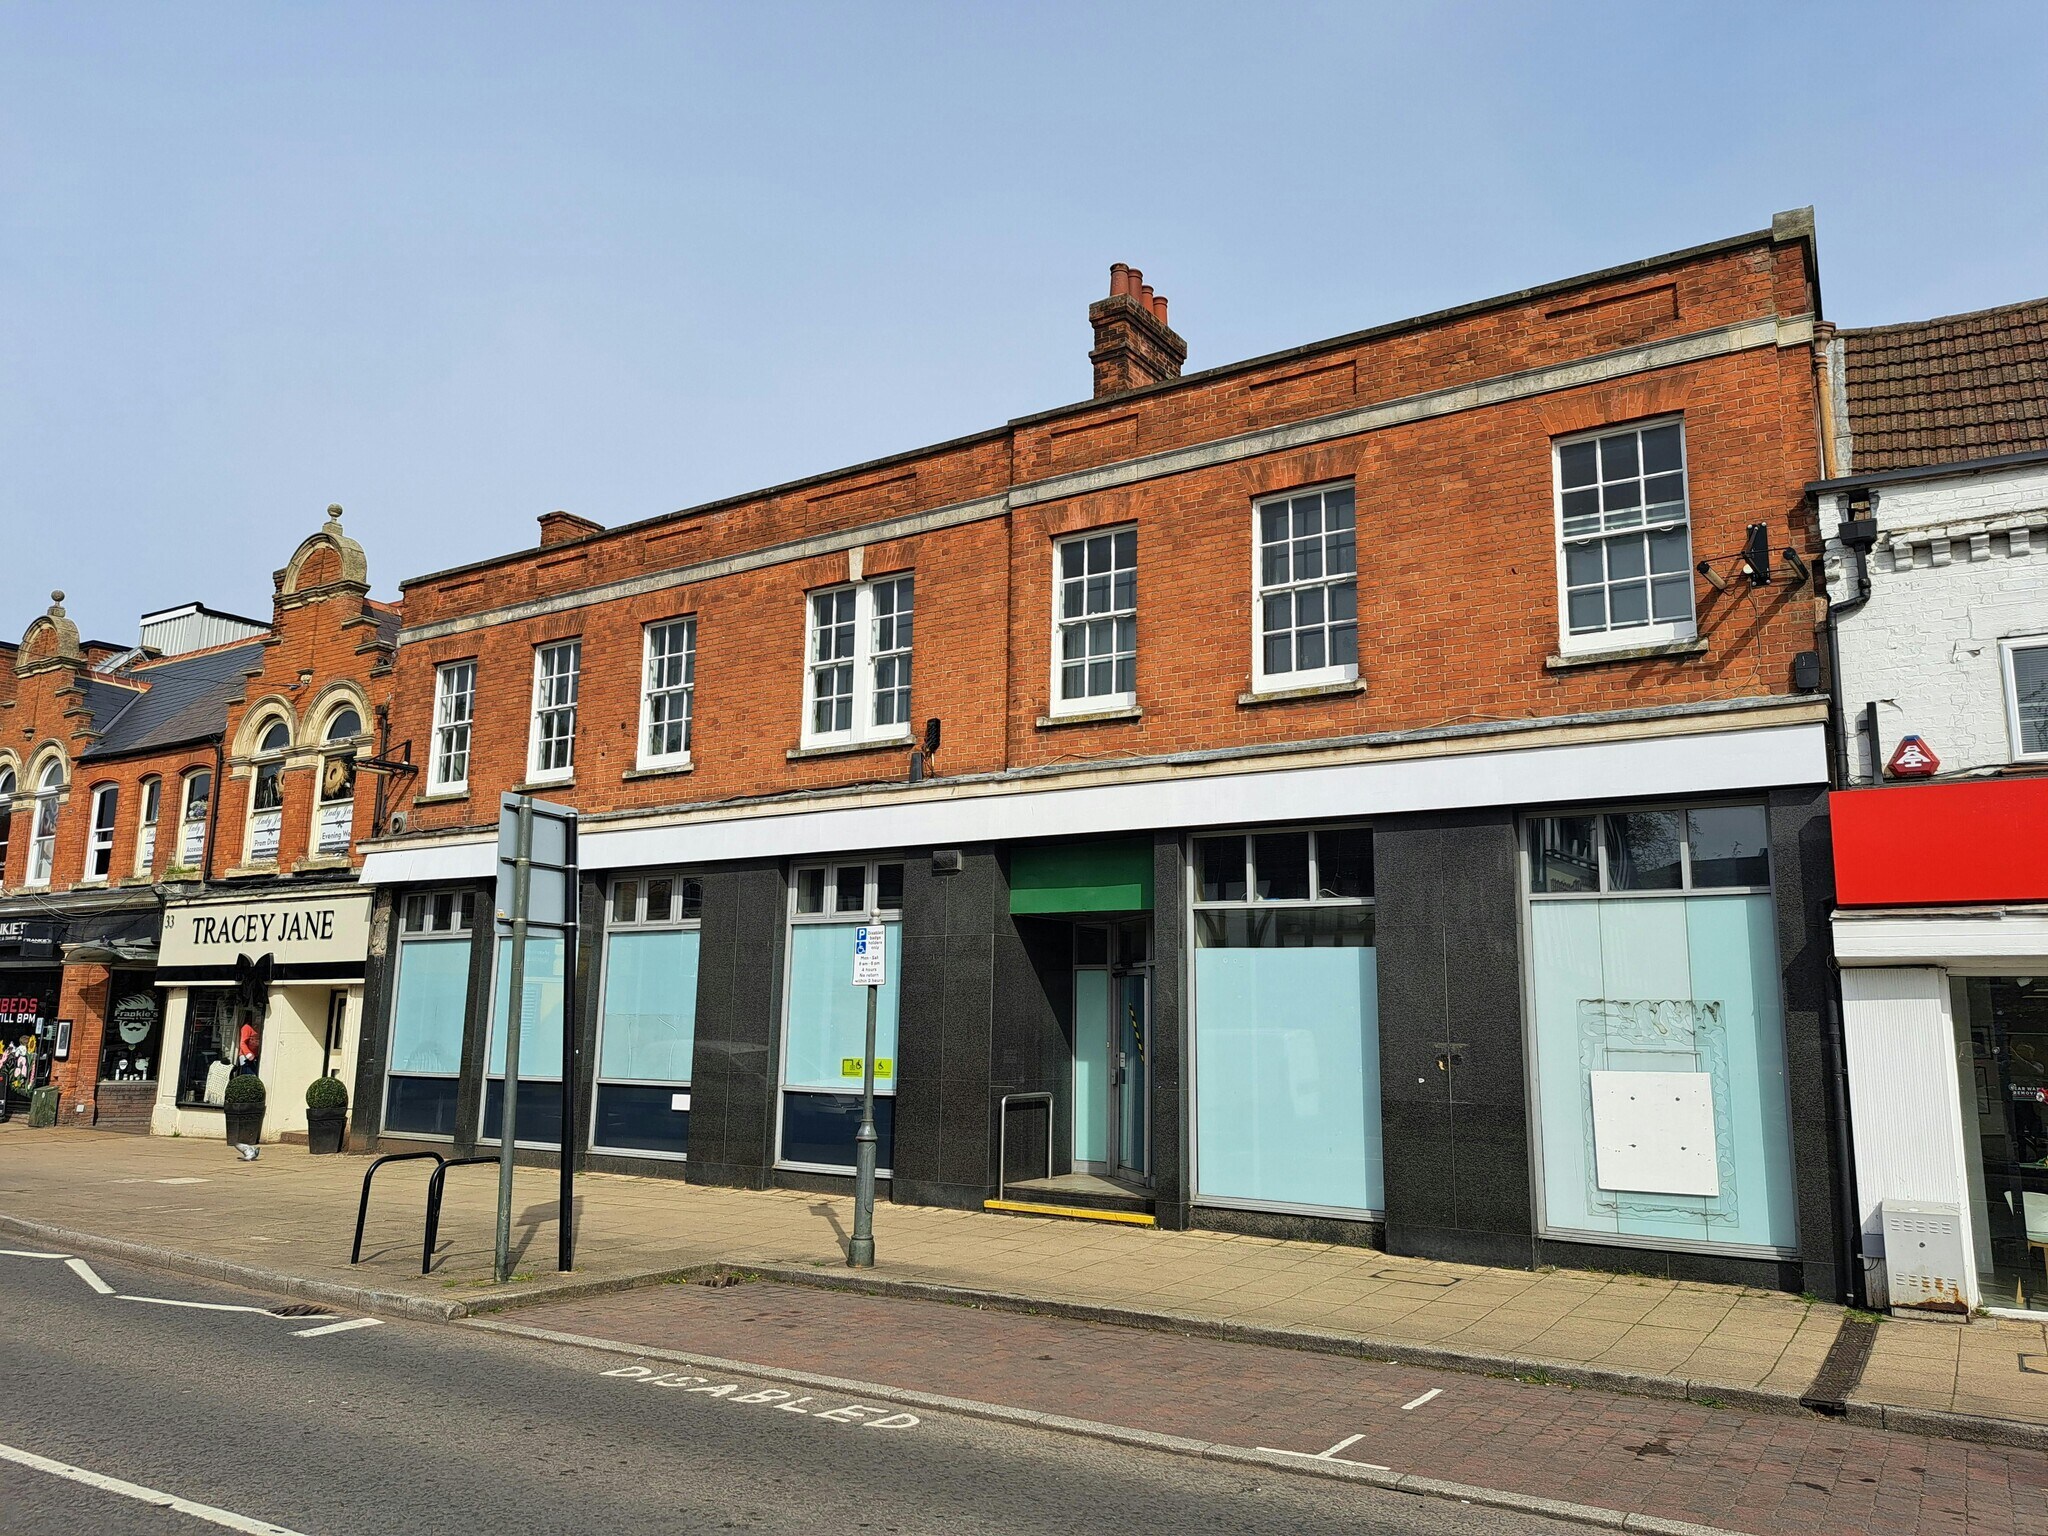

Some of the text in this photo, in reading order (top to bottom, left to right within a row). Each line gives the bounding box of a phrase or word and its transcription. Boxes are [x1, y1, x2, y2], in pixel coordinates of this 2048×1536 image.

[322, 831, 341, 840] Evening
[165, 915, 175, 929] 33
[192, 910, 335, 945] TRACEY JANE
[0, 998, 38, 1013] BEDS
[17, 1013, 36, 1024] 8PM
[599, 1366, 920, 1429] DISABLED
